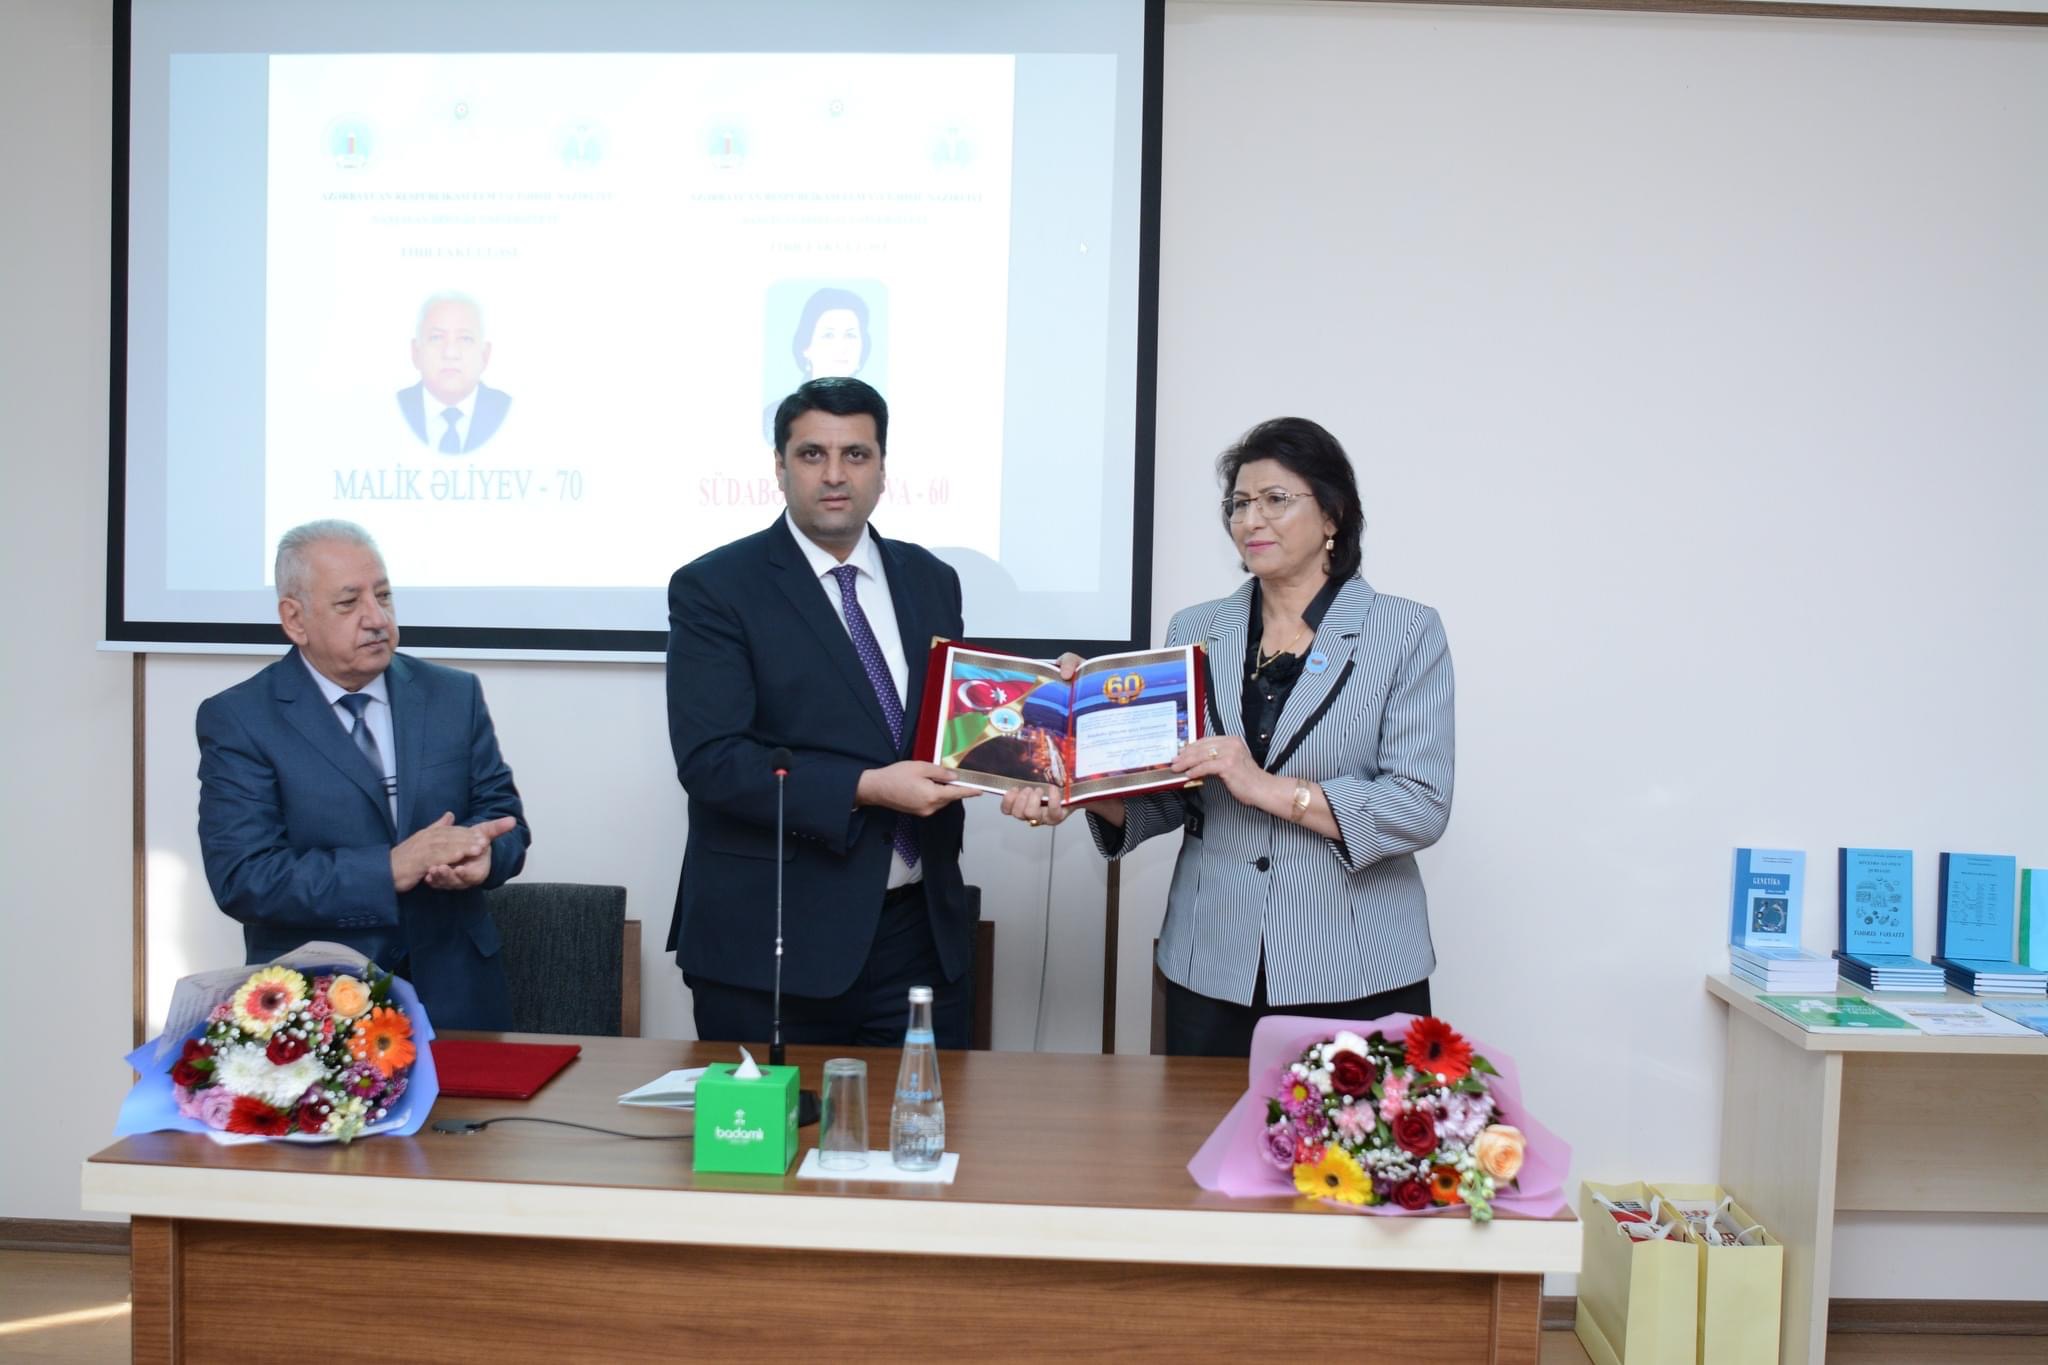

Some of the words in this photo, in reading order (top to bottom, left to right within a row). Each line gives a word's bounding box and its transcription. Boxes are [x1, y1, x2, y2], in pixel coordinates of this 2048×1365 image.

[333, 463, 424, 501] MALİK
[430, 463, 533, 501] ƏLİYEV
[557, 469, 583, 502] 70
[928, 477, 950, 506] 60
[1106, 673, 1140, 698] 60
